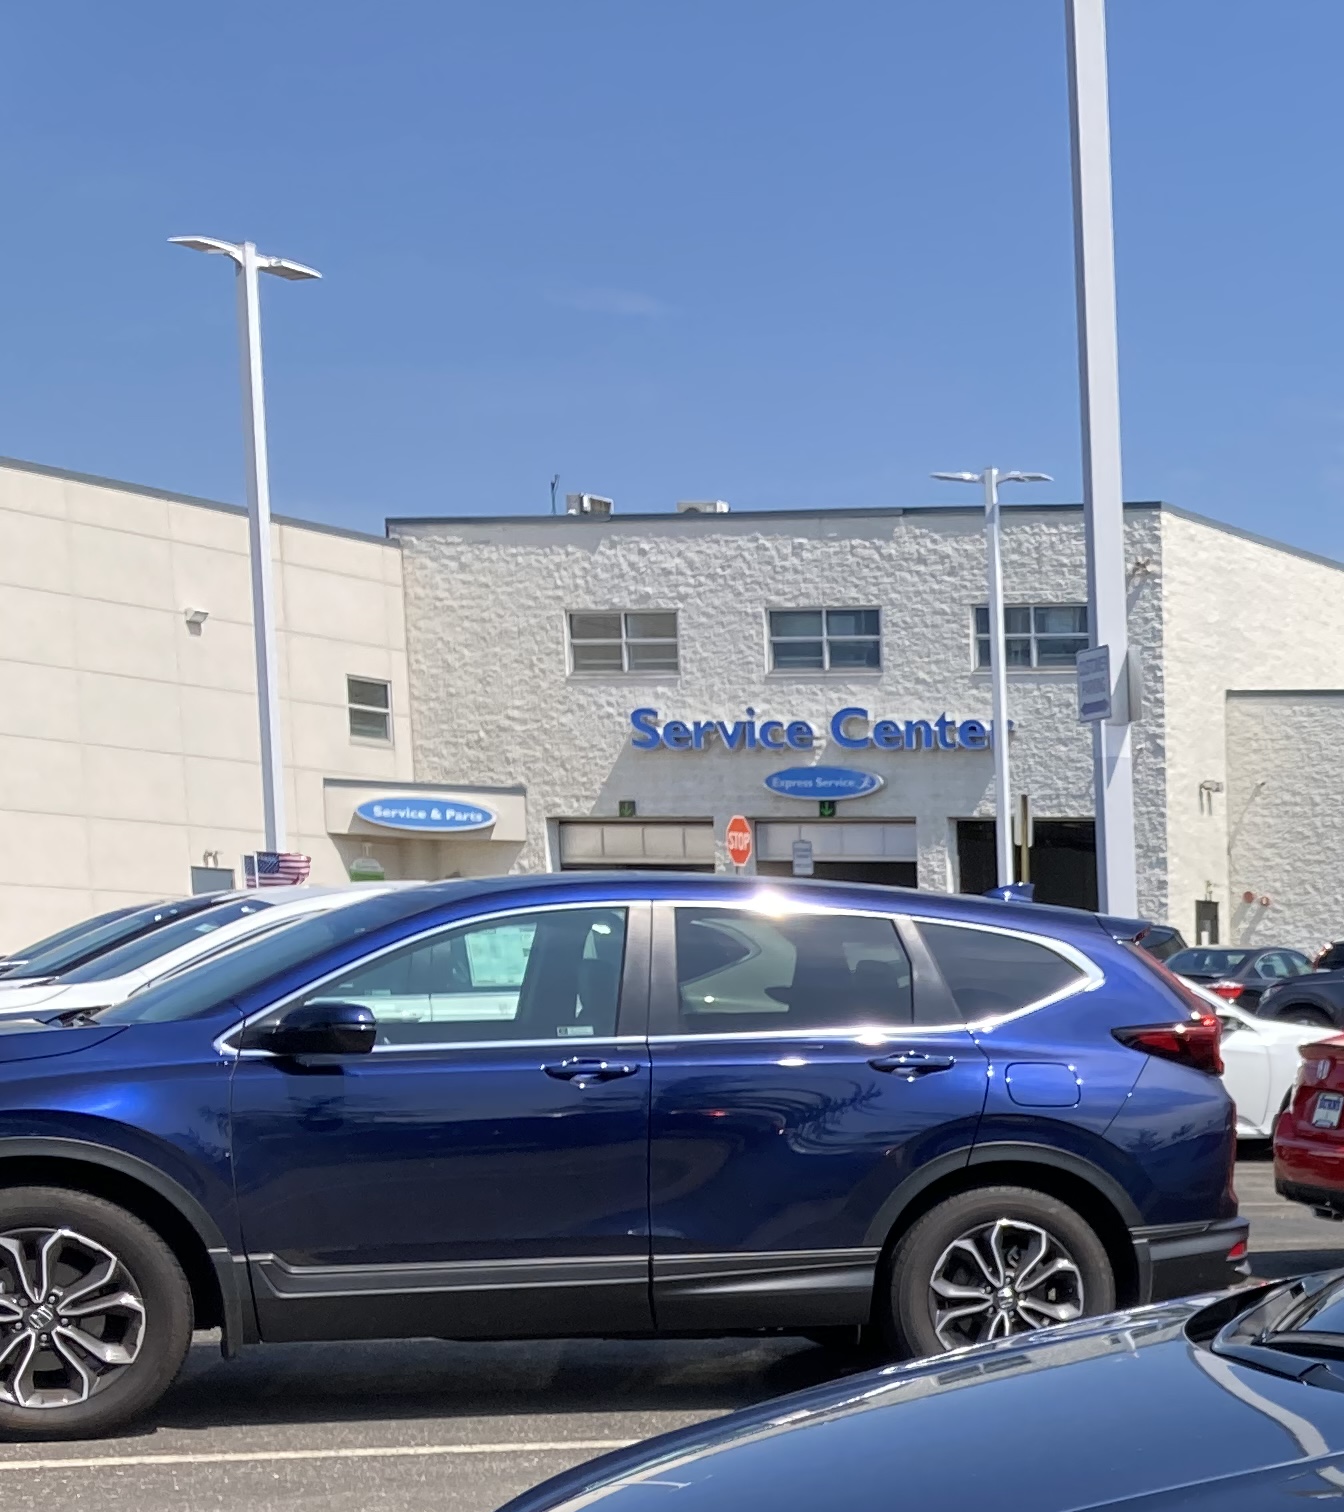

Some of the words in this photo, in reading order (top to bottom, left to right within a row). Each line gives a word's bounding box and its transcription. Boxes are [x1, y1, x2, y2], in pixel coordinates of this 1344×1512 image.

[630, 707, 815, 751] Service
[772, 777, 813, 791] Express
[815, 777, 856, 789] Service
[373, 805, 427, 820] Service
[430, 808, 442, 821] &
[446, 808, 483, 823] Parts
[729, 831, 750, 851] STOP
